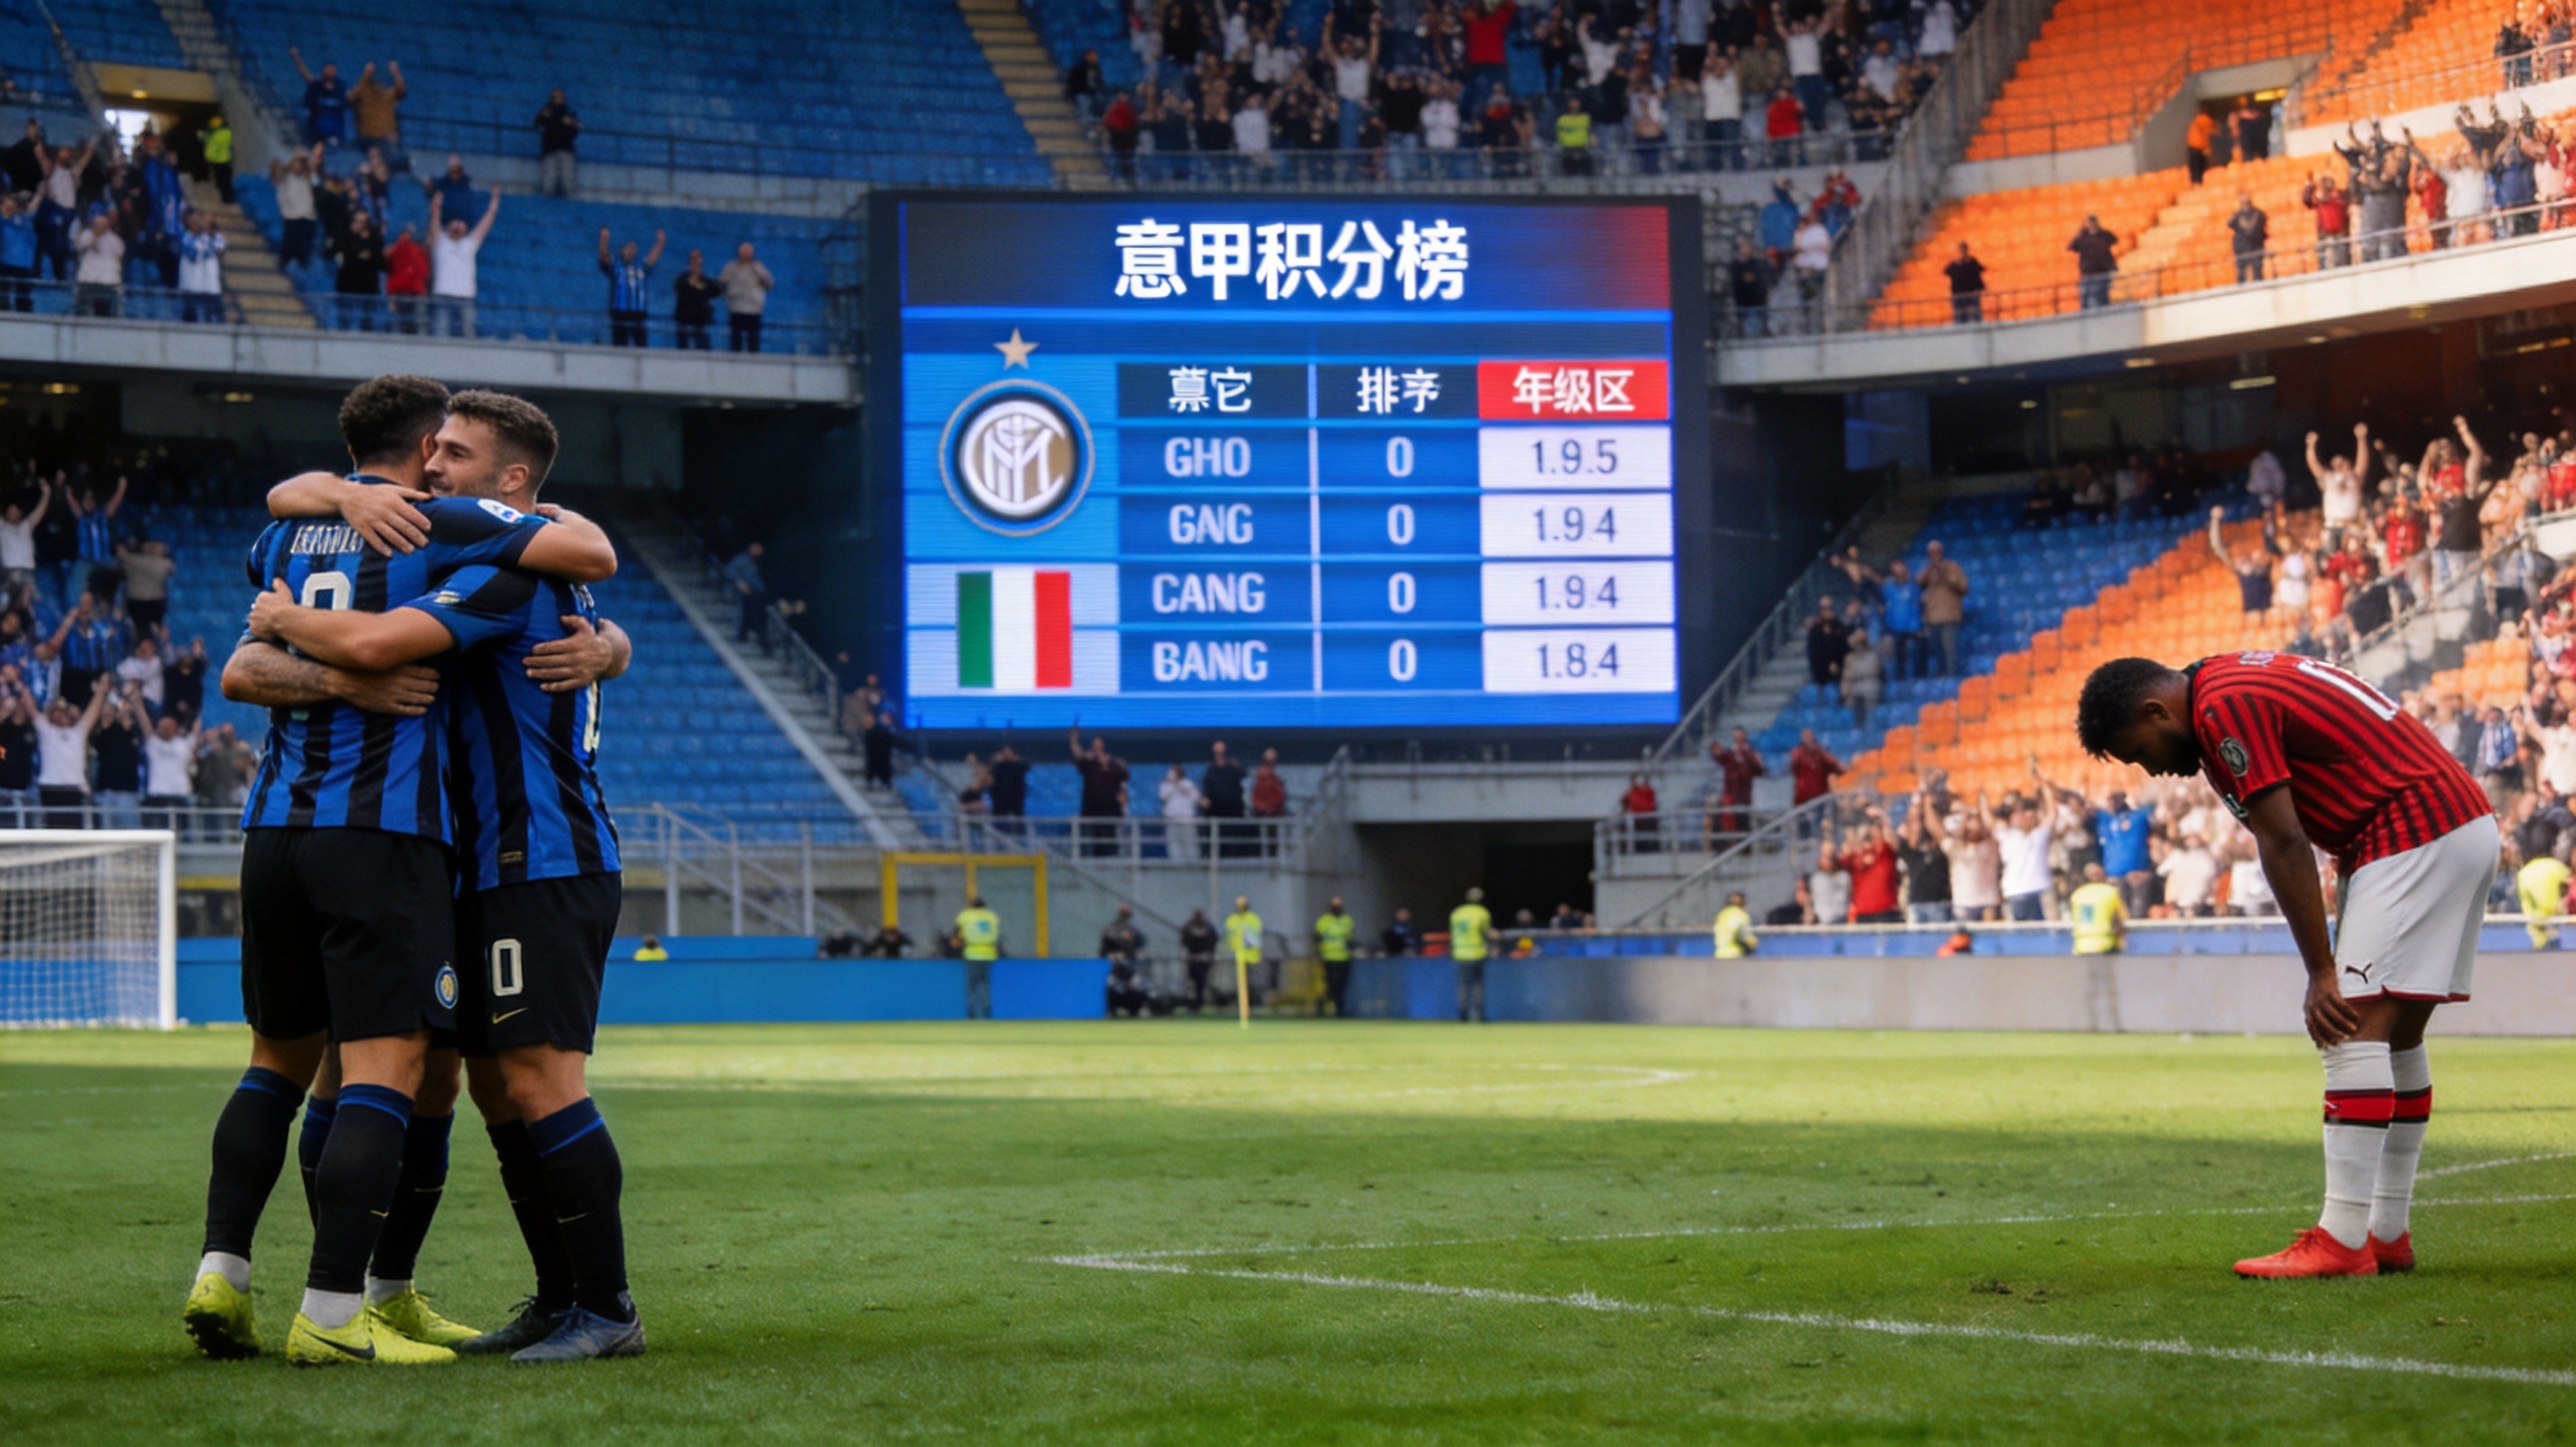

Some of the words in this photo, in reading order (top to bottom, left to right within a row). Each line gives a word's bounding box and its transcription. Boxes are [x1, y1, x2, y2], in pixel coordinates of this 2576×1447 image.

[1114, 218, 1469, 301] 意甲积分榜
[1512, 365, 1636, 415] 年级区
[1387, 437, 1414, 478] 0
[1532, 439, 1618, 475] 1.9.5
[1387, 504, 1415, 545] 0
[1152, 572, 1265, 613] CANG
[1388, 572, 1416, 613] 0
[1388, 639, 1417, 682] 0
[1538, 642, 1620, 678] 1.8.4
